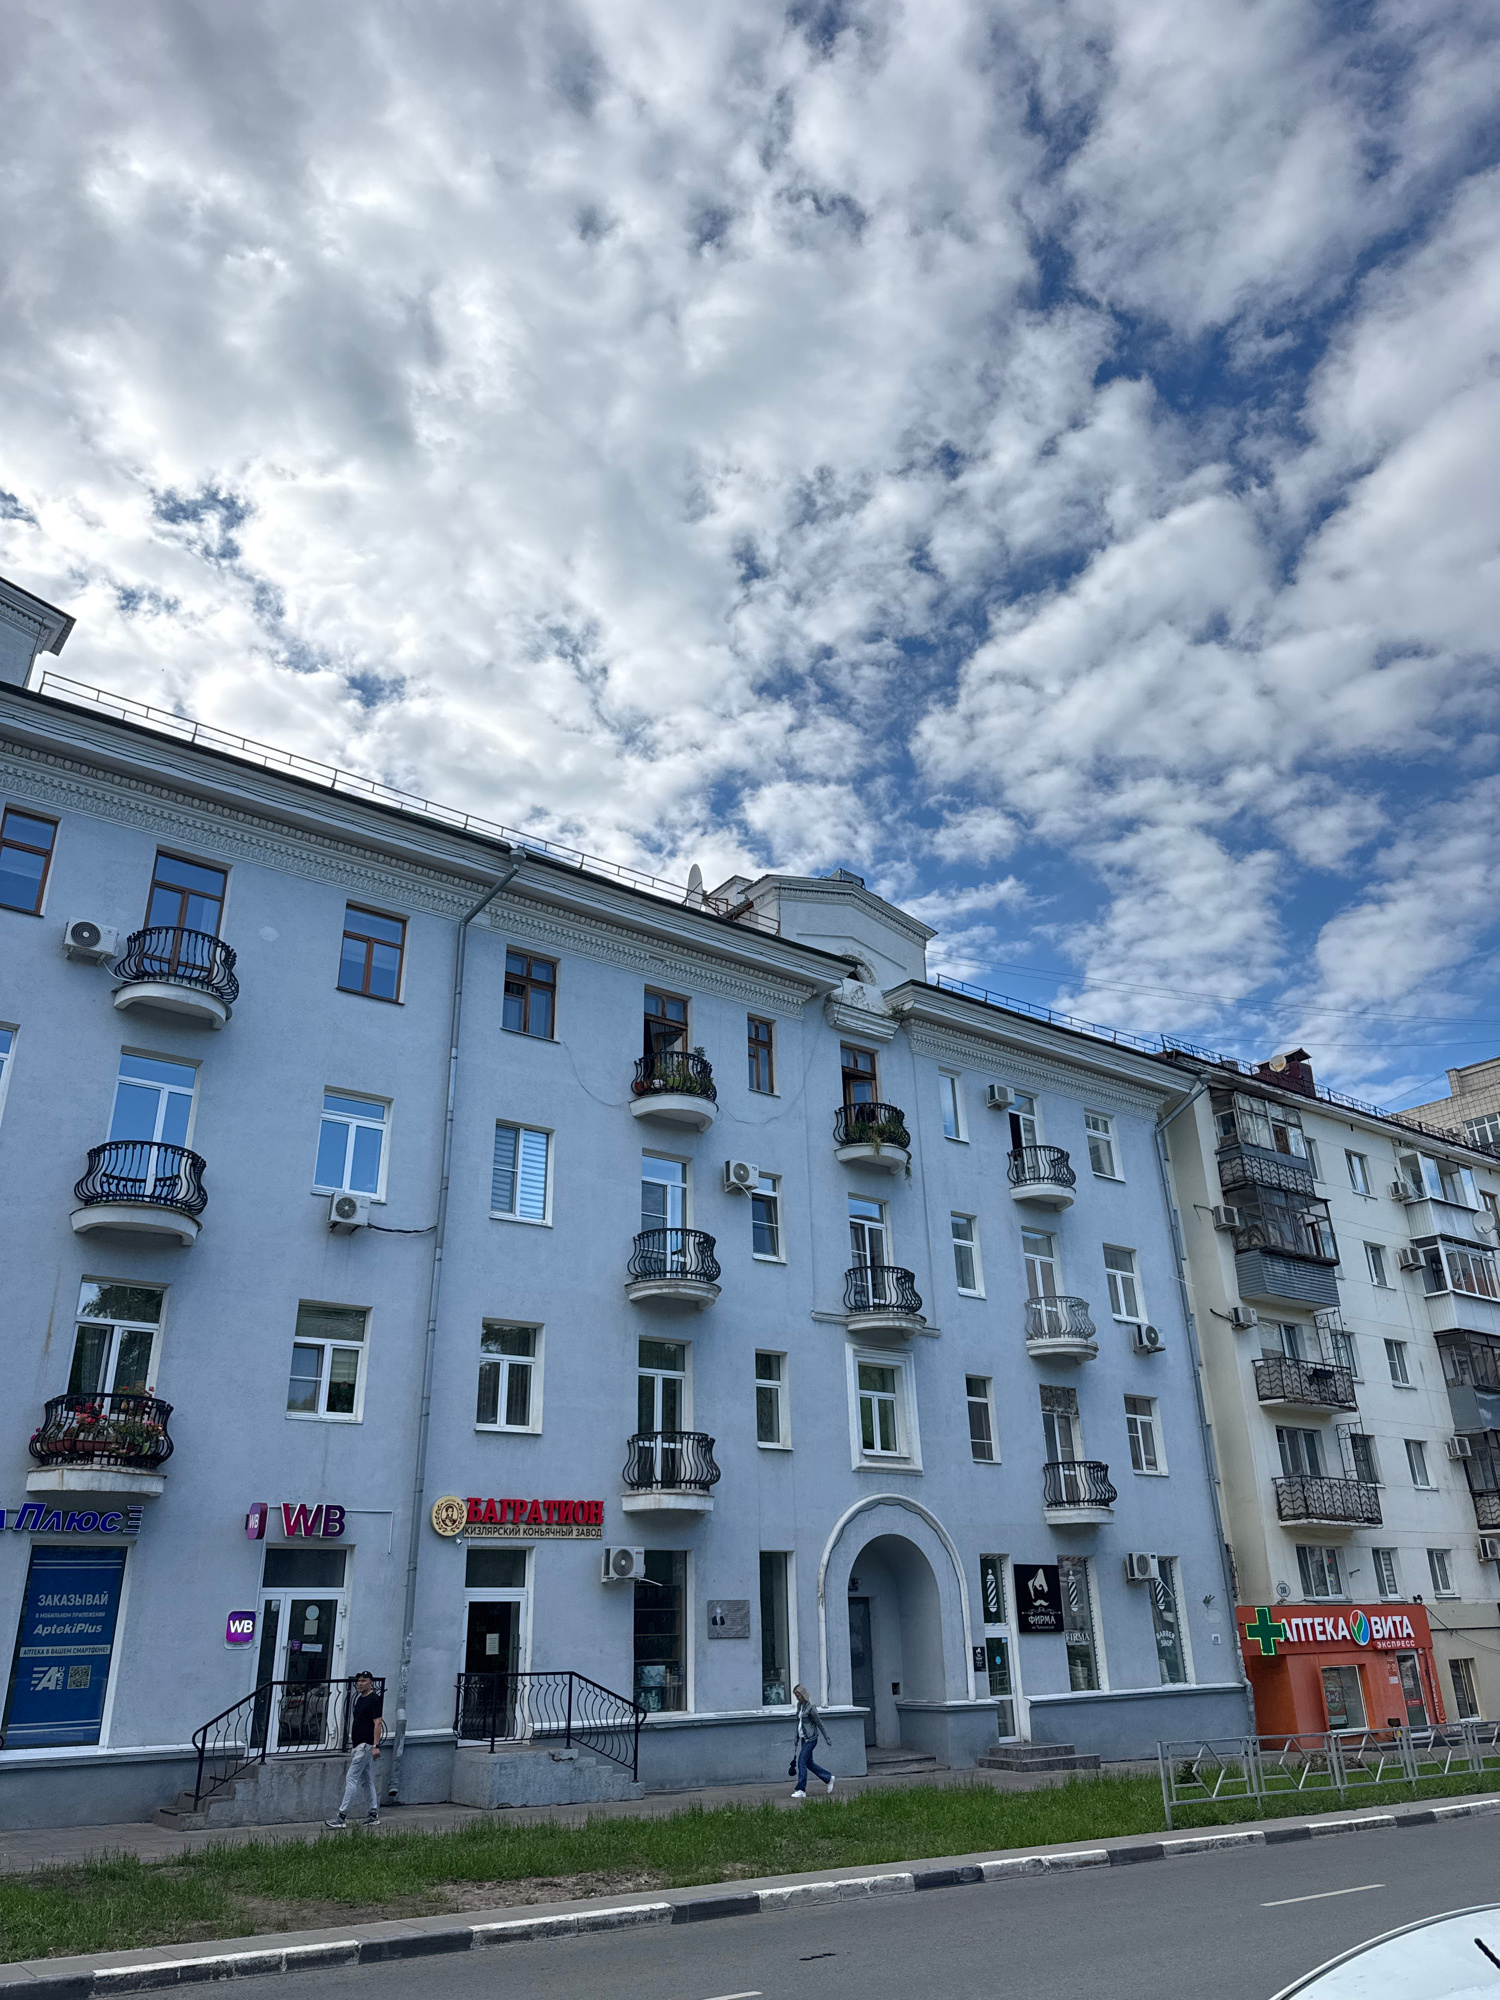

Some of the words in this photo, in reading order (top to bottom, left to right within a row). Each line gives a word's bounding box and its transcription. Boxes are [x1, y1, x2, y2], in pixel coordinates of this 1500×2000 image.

[466, 1497, 605, 1524] БАГРАТИОН
[249, 1513, 260, 1529] WB
[281, 1502, 346, 1538] WB
[464, 1525, 521, 1537] КИЗЛЯРСКИЙ
[522, 1526, 574, 1537] КОНЬЯЧНЫЙ
[575, 1527, 602, 1538] ЗАВОД
[38, 1590, 109, 1607] ЗАКАЗЫВАЙ
[229, 1619, 254, 1634] WB
[1028, 1615, 1056, 1625] ФИРМА
[1371, 1615, 1415, 1639] ВИТА
[33, 1623, 103, 1637] AptekiPlus
[23, 1648, 45, 1656] АПТЕКА
[51, 1647, 72, 1655] ВАШЕМ
[1376, 1639, 1416, 1649] ЭКСПРЕСС
